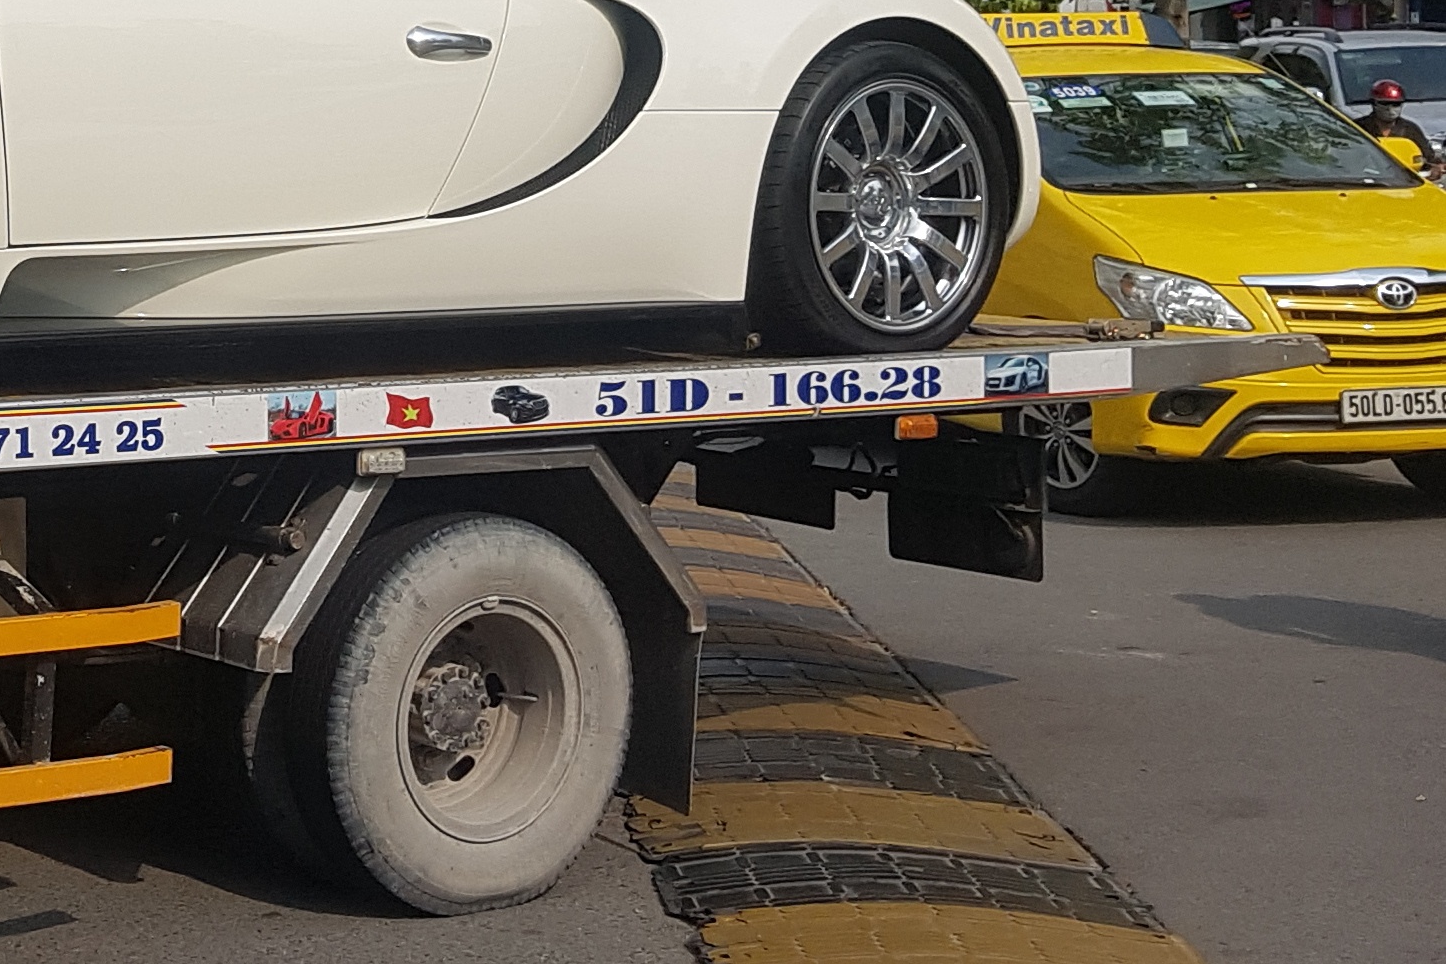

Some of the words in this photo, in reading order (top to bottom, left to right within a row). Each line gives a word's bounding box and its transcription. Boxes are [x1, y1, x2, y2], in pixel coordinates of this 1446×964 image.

[984, 15, 1129, 39] Vinataxi
[1053, 85, 1097, 98] 5039
[595, 378, 710, 417] 51D
[728, 391, 744, 402] -
[767, 365, 942, 408] 166.28
[51, 422, 102, 457] 24
[115, 417, 164, 452] 25
